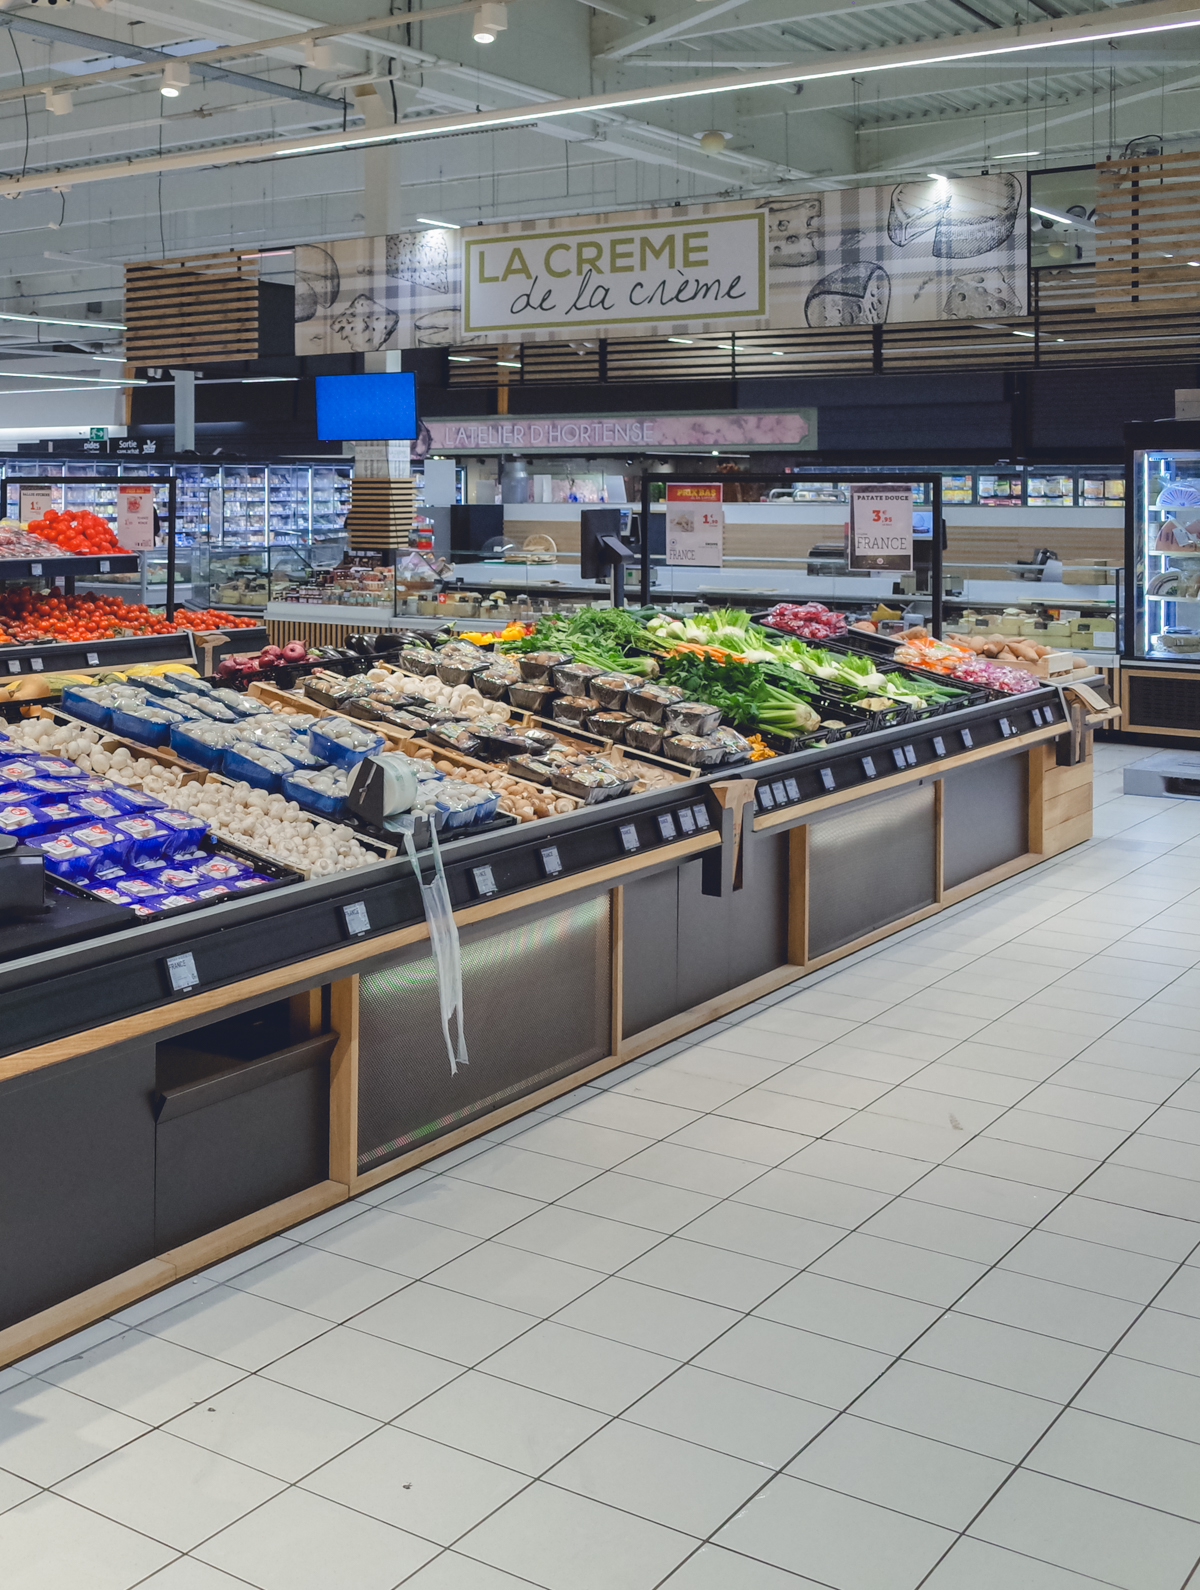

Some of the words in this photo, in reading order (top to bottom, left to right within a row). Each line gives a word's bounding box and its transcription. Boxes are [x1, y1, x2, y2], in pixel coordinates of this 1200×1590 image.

[478, 247, 533, 284] LA
[543, 231, 709, 278] CREME
[510, 275, 557, 315] de
[564, 268, 615, 315] la
[629, 269, 746, 306] crème
[445, 425, 525, 445] L'ATELIER
[530, 422, 654, 444] D'HORTENSE
[84, 441, 100, 449] pides
[119, 440, 137, 448] Sortie
[676, 488, 698, 496] PRIX
[699, 488, 717, 497] BAS
[856, 536, 907, 550] FRANCE
[669, 549, 696, 561] FRANCE
